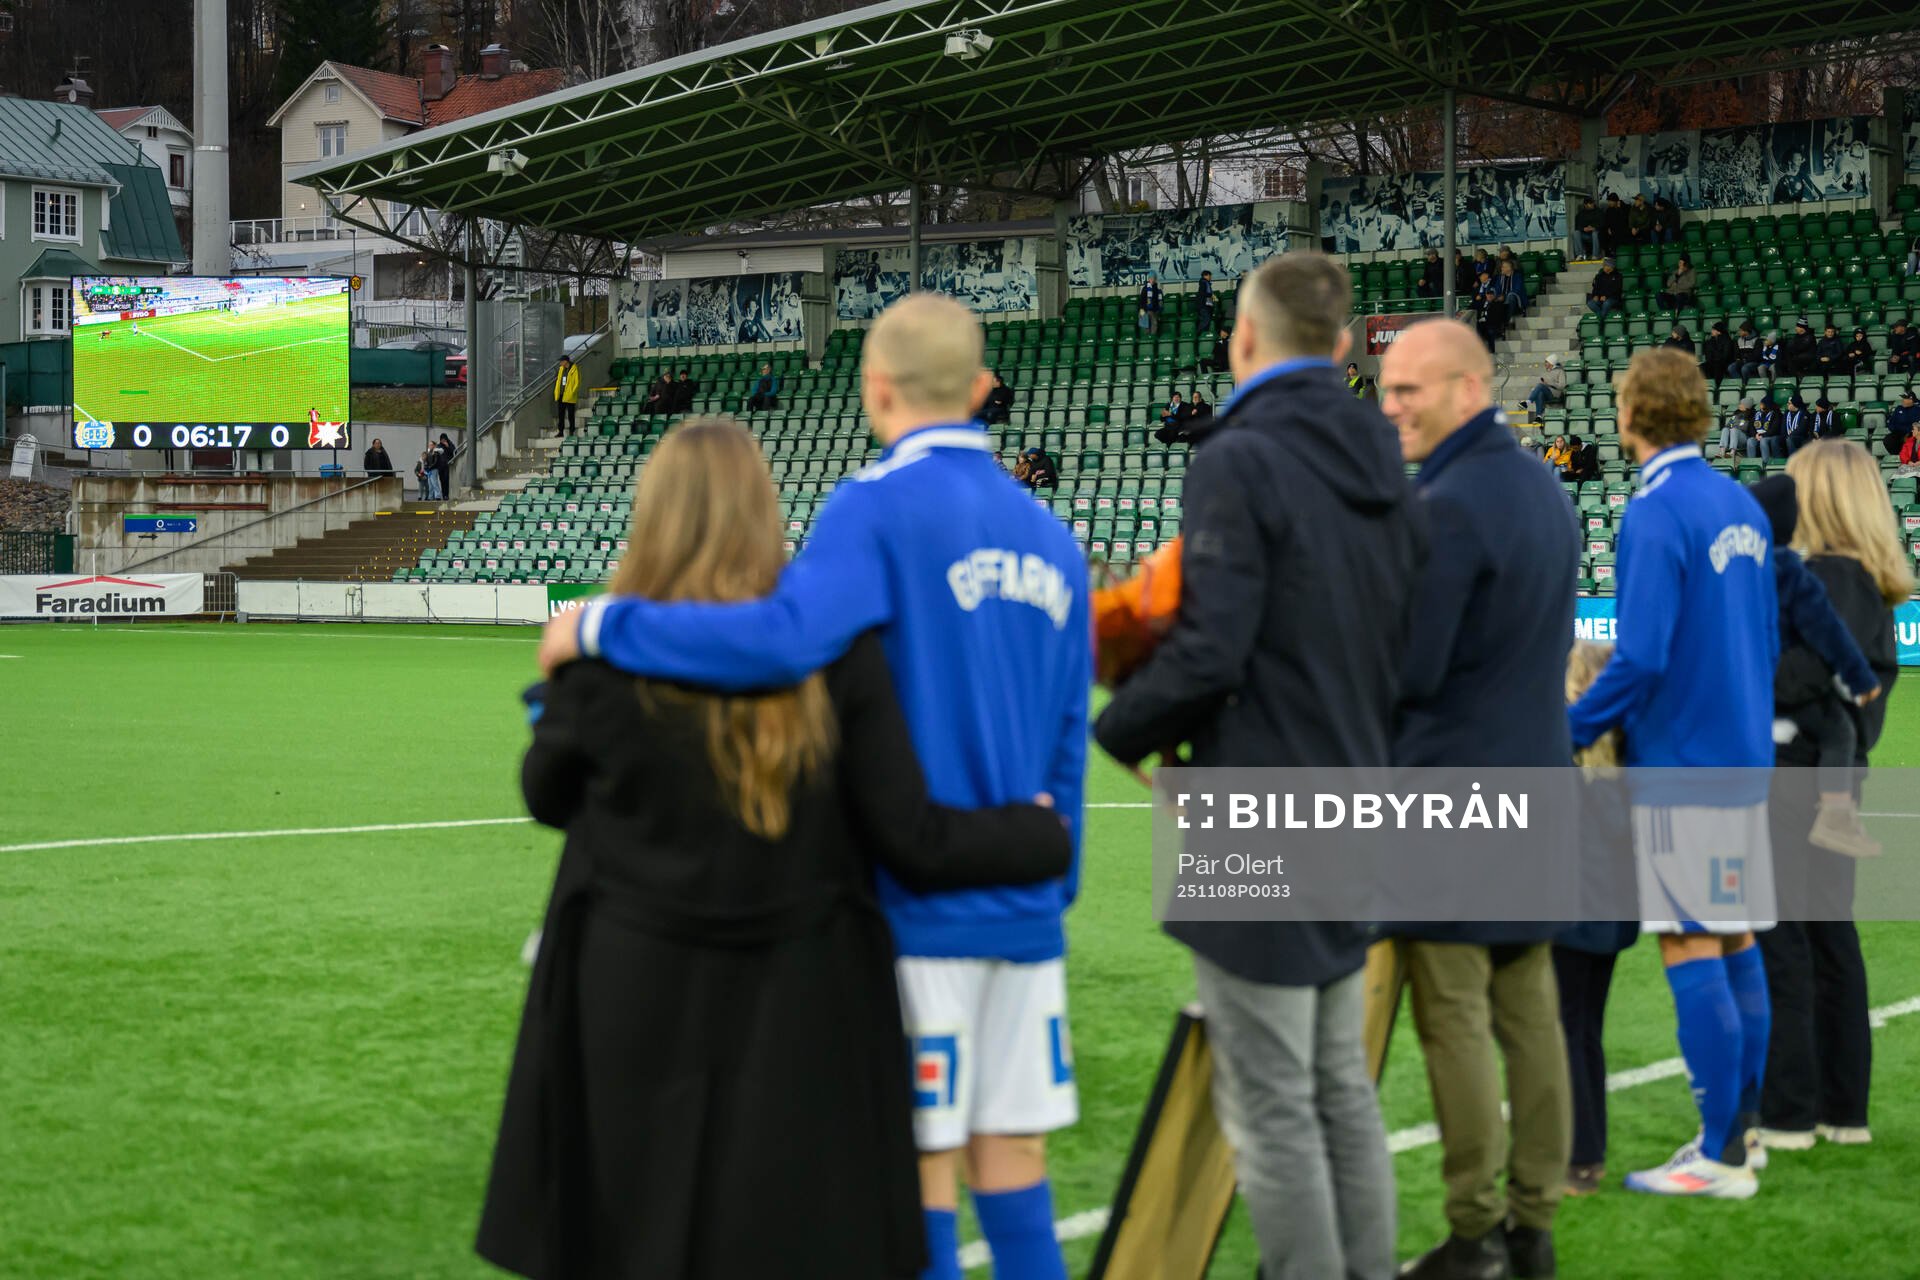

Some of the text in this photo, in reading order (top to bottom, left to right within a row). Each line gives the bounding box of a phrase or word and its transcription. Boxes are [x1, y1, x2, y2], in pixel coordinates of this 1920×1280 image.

[133, 425, 290, 448] 0 06:17 0
[36, 593, 166, 613] Faradium
